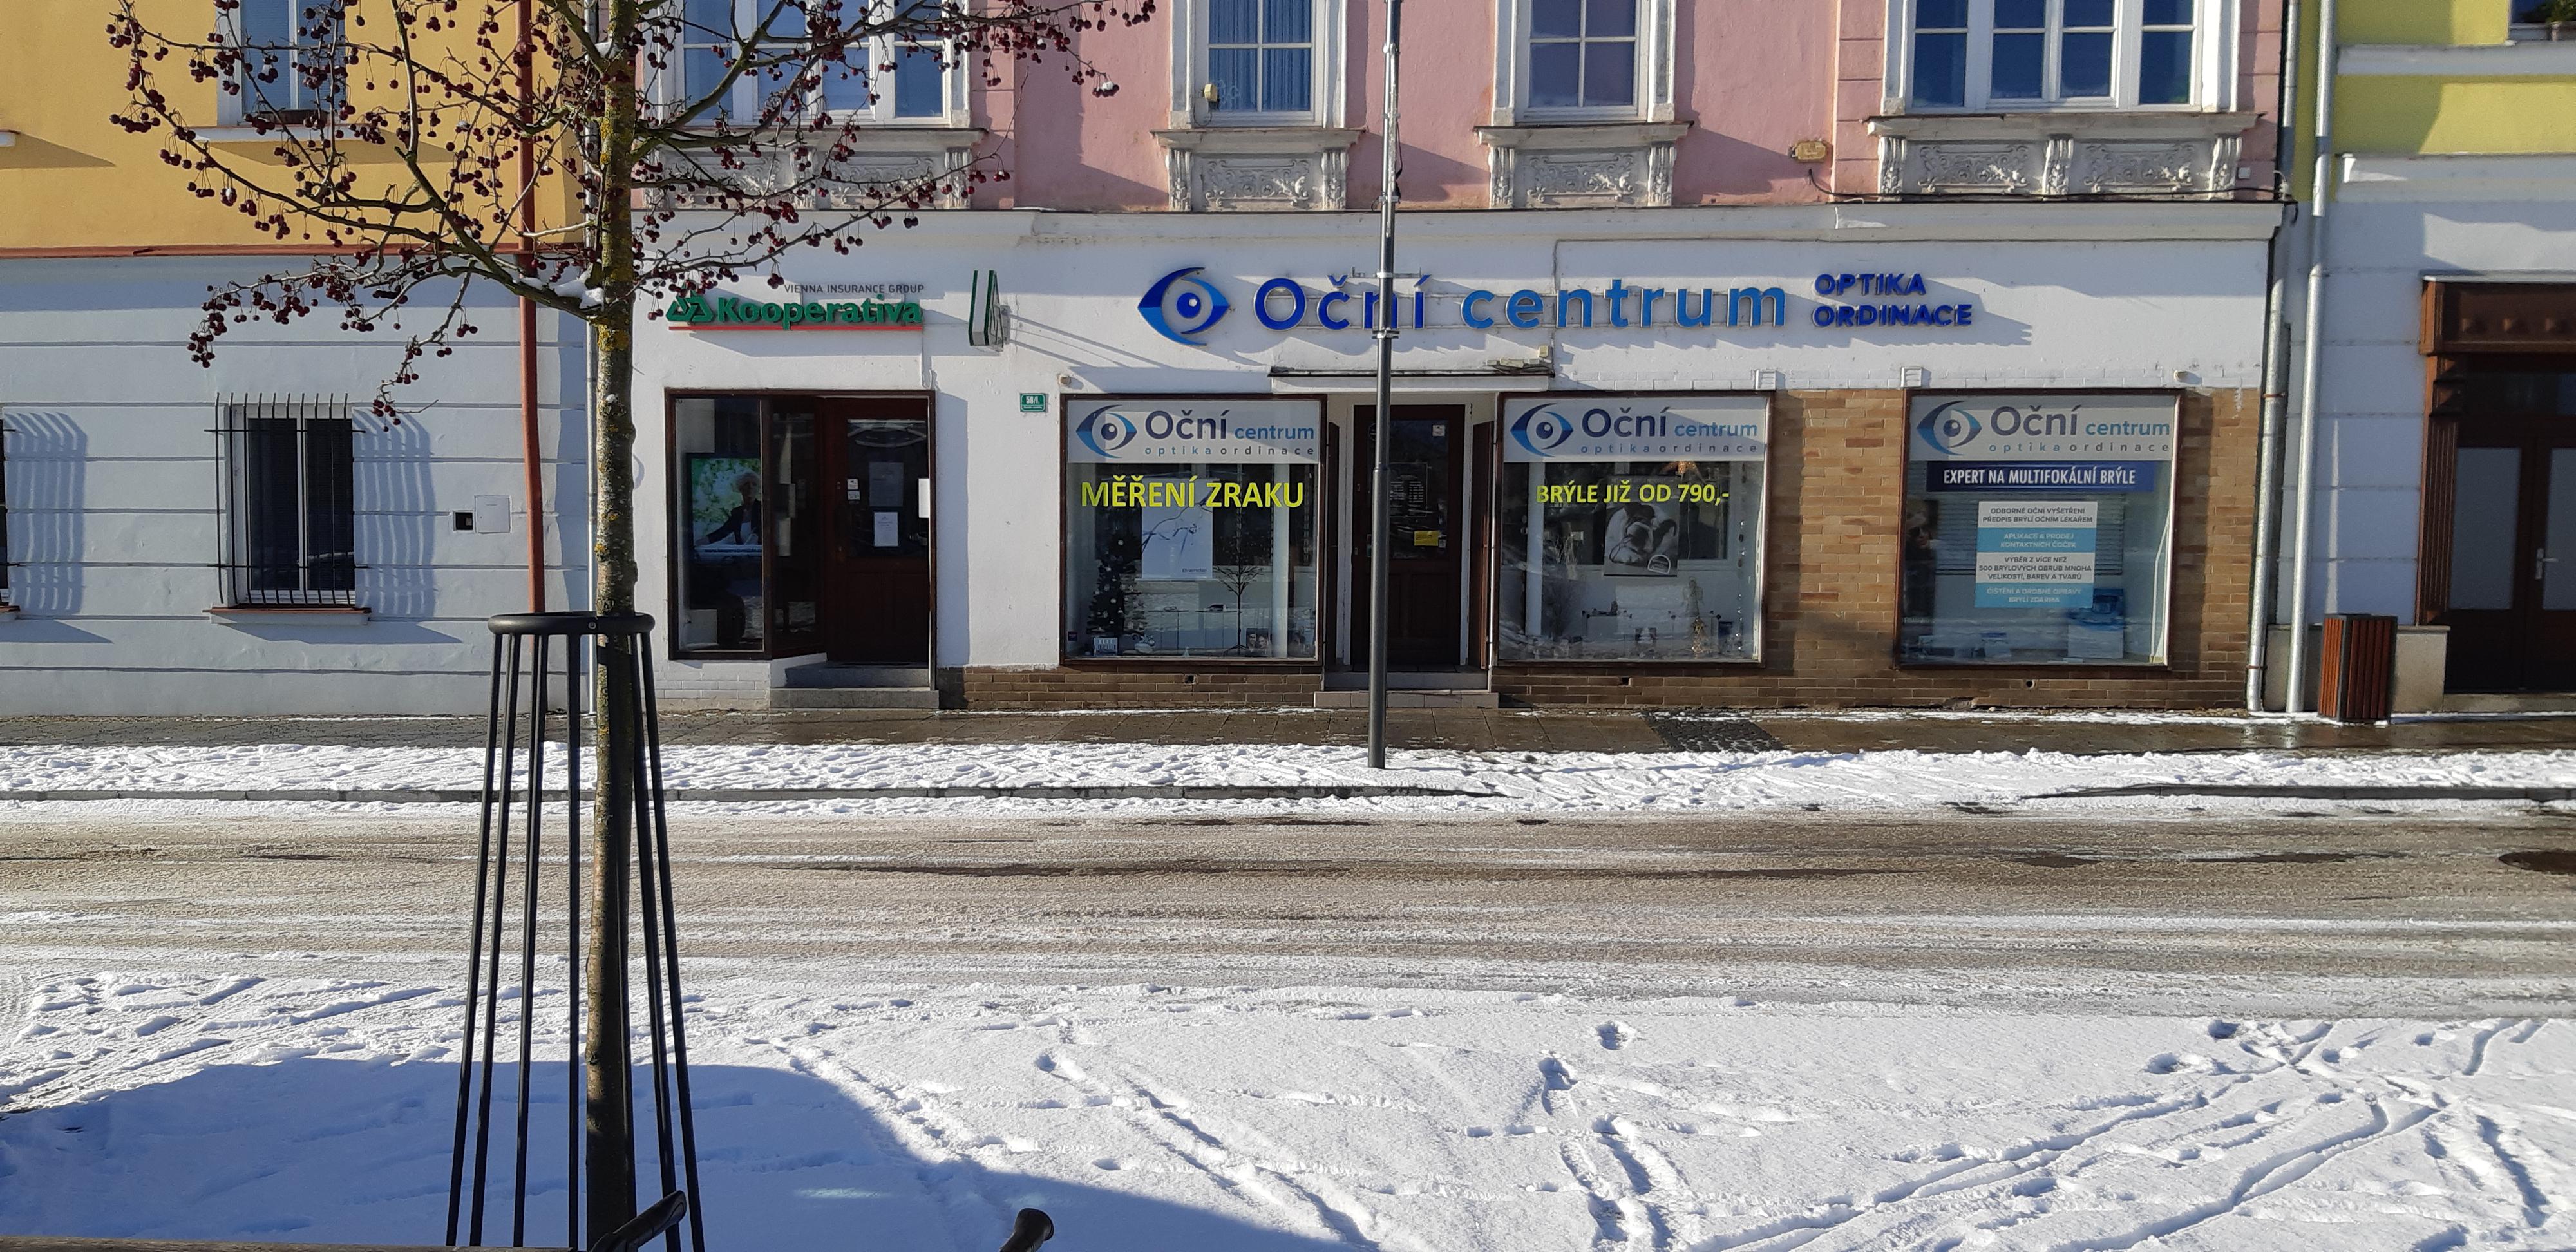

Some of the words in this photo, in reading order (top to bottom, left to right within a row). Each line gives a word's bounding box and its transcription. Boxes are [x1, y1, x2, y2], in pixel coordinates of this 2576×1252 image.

[784, 285, 824, 294] VIENNA
[827, 285, 885, 294] INSURANCE
[889, 285, 925, 294] GROUP
[1812, 273, 1927, 295] OPTIKA
[717, 294, 923, 330] Kooperativa
[1253, 274, 1431, 330] Oční
[1460, 278, 1786, 329] centrum
[1812, 304, 1973, 327] ORDINACE
[1145, 410, 1230, 439] Oční
[1235, 425, 1314, 439] centrum
[1582, 406, 1671, 438] Oční
[1674, 422, 1757, 437] centrum
[1990, 405, 2081, 436] Oční
[2085, 421, 2170, 435] centrum
[1943, 469, 1985, 484] EXPERT
[1988, 469, 2005, 484] NA
[2009, 466, 2097, 484] MULTIFOKÁLNÍ
[2099, 466, 2136, 484] BRÝLE
[1081, 475, 1198, 507] MĚŘENÍ
[1206, 482, 1304, 507] ZRAKU
[1536, 480, 1598, 503] BRÝLE
[1604, 479, 1631, 503] JIŽ
[1639, 484, 1671, 502] OD
[1678, 484, 1730, 506] 790,-
